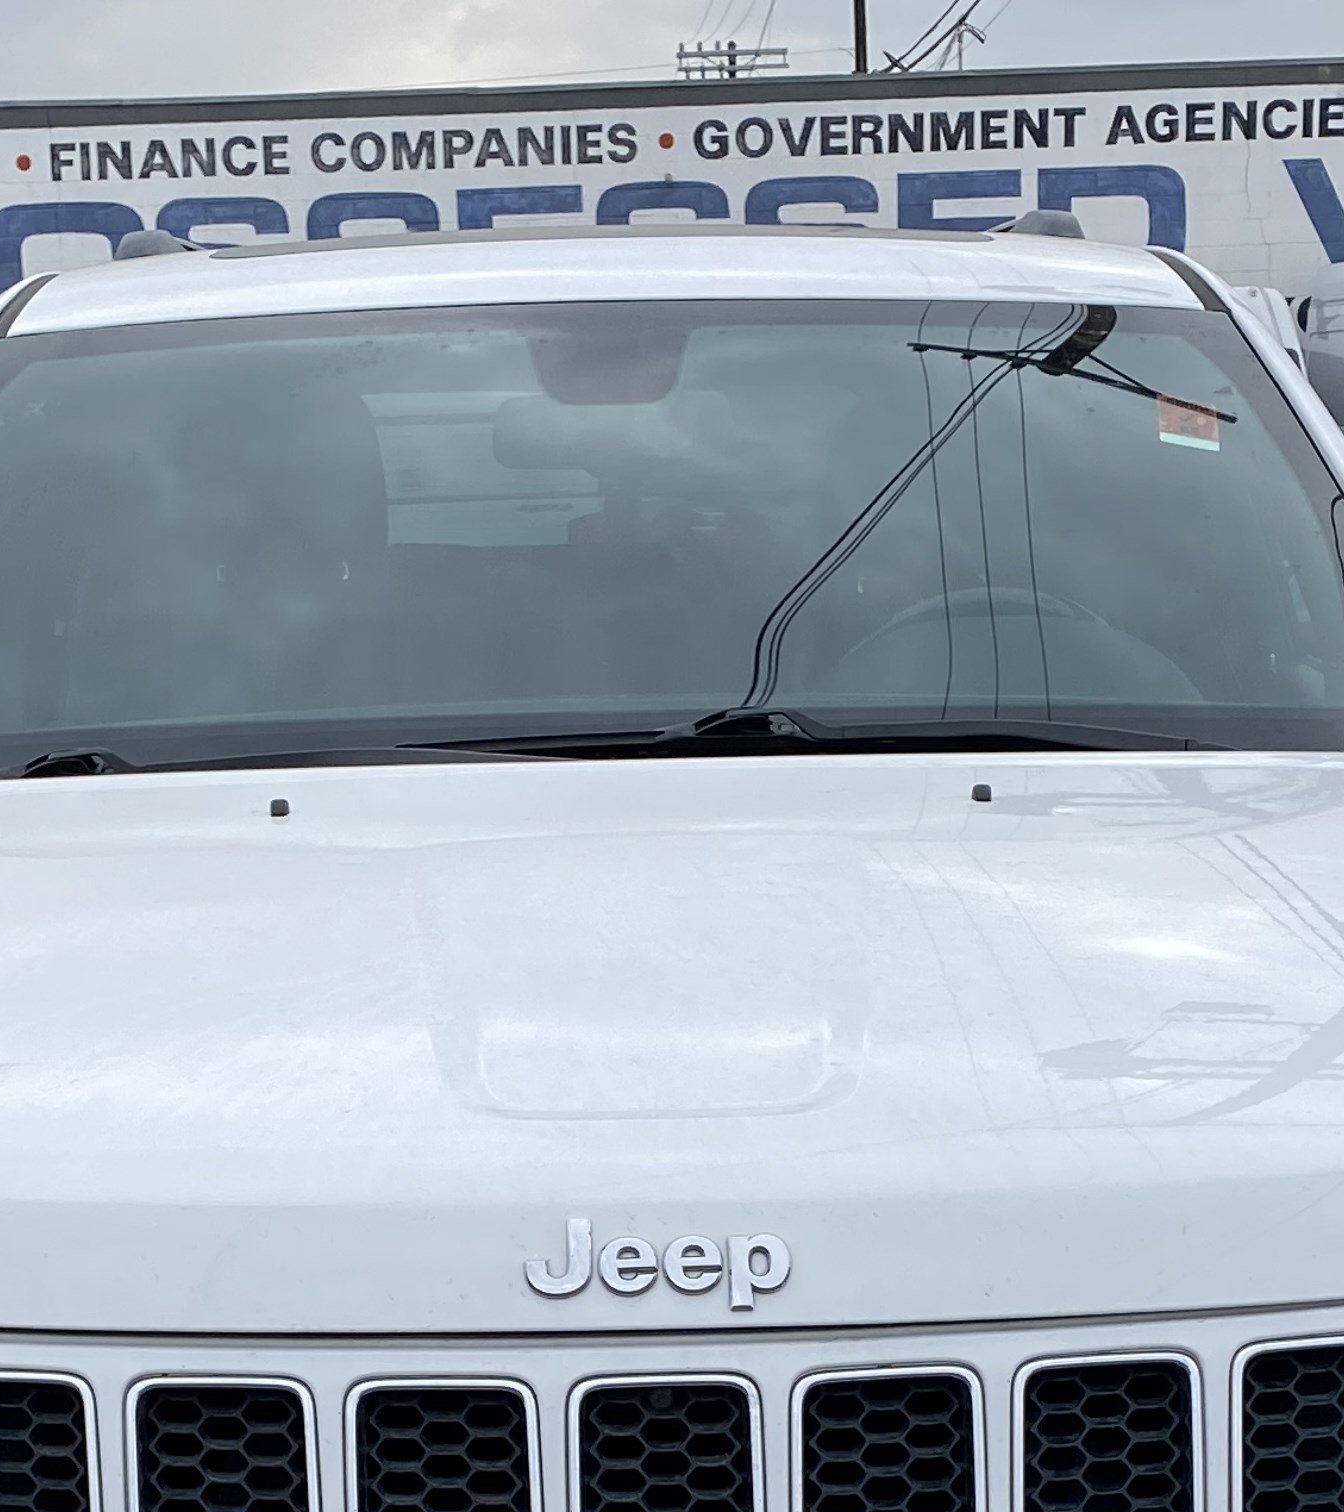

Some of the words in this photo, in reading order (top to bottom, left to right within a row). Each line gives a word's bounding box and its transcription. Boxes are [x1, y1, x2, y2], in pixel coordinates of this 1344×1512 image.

[49, 135, 290, 182] FINANCE
[310, 122, 638, 174] COMPANIES
[692, 107, 1087, 160] GOVERNMENT
[523, 1217, 793, 1312] Jeep
